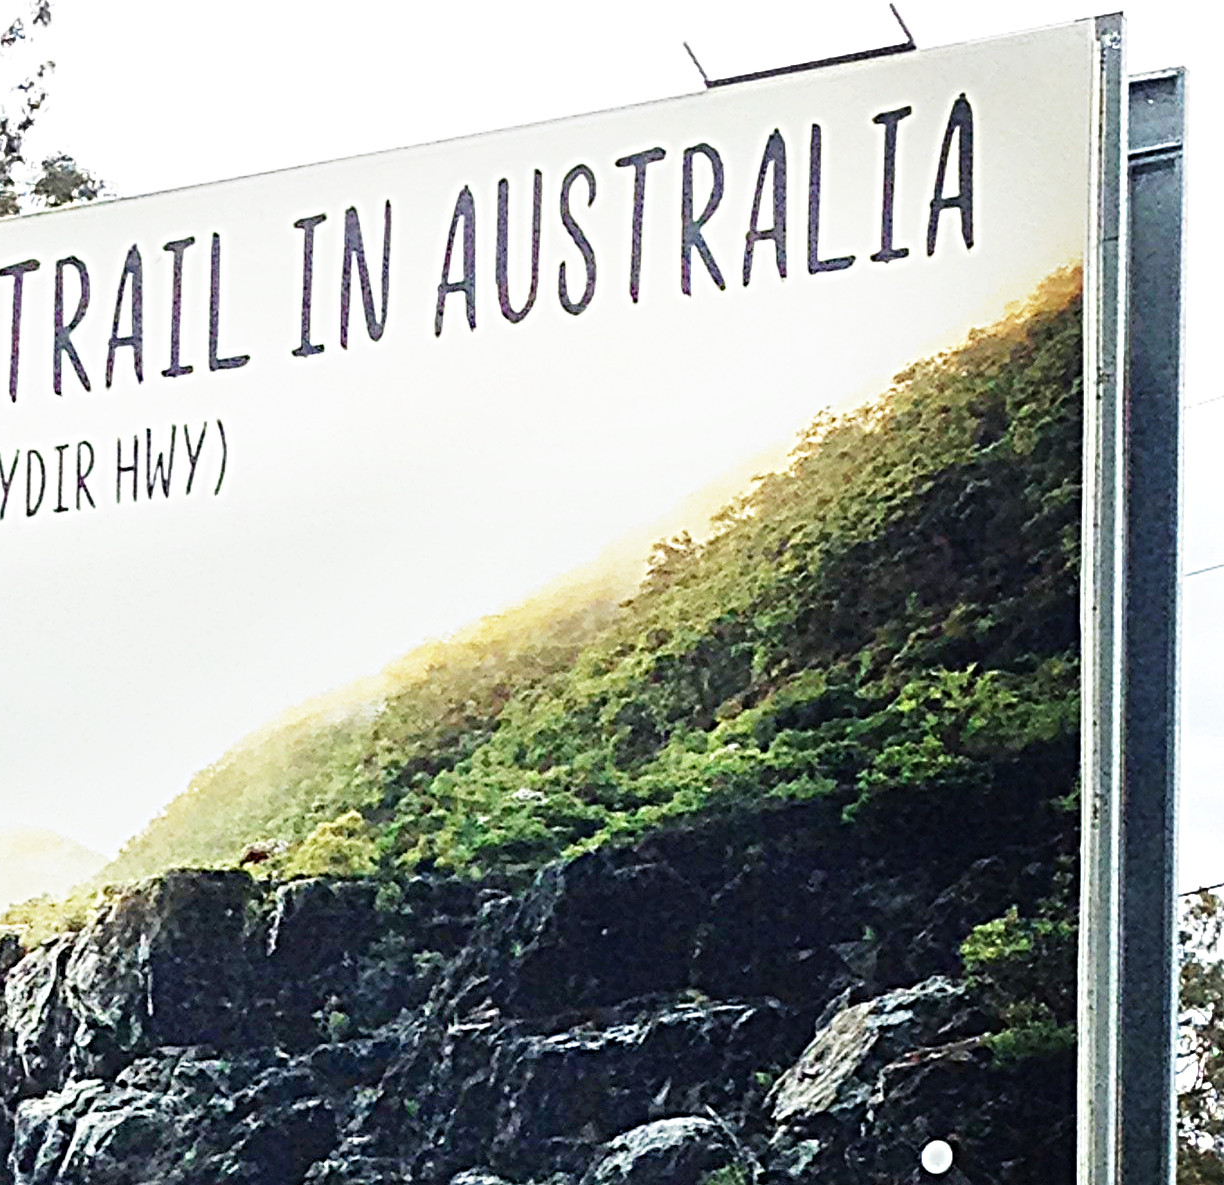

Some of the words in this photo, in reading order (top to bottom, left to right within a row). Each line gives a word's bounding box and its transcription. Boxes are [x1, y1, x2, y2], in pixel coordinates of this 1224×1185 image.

[291, 199, 392, 357] IN
[435, 93, 975, 338] AUSTRALIA
[115, 419, 229, 504] HWY)
